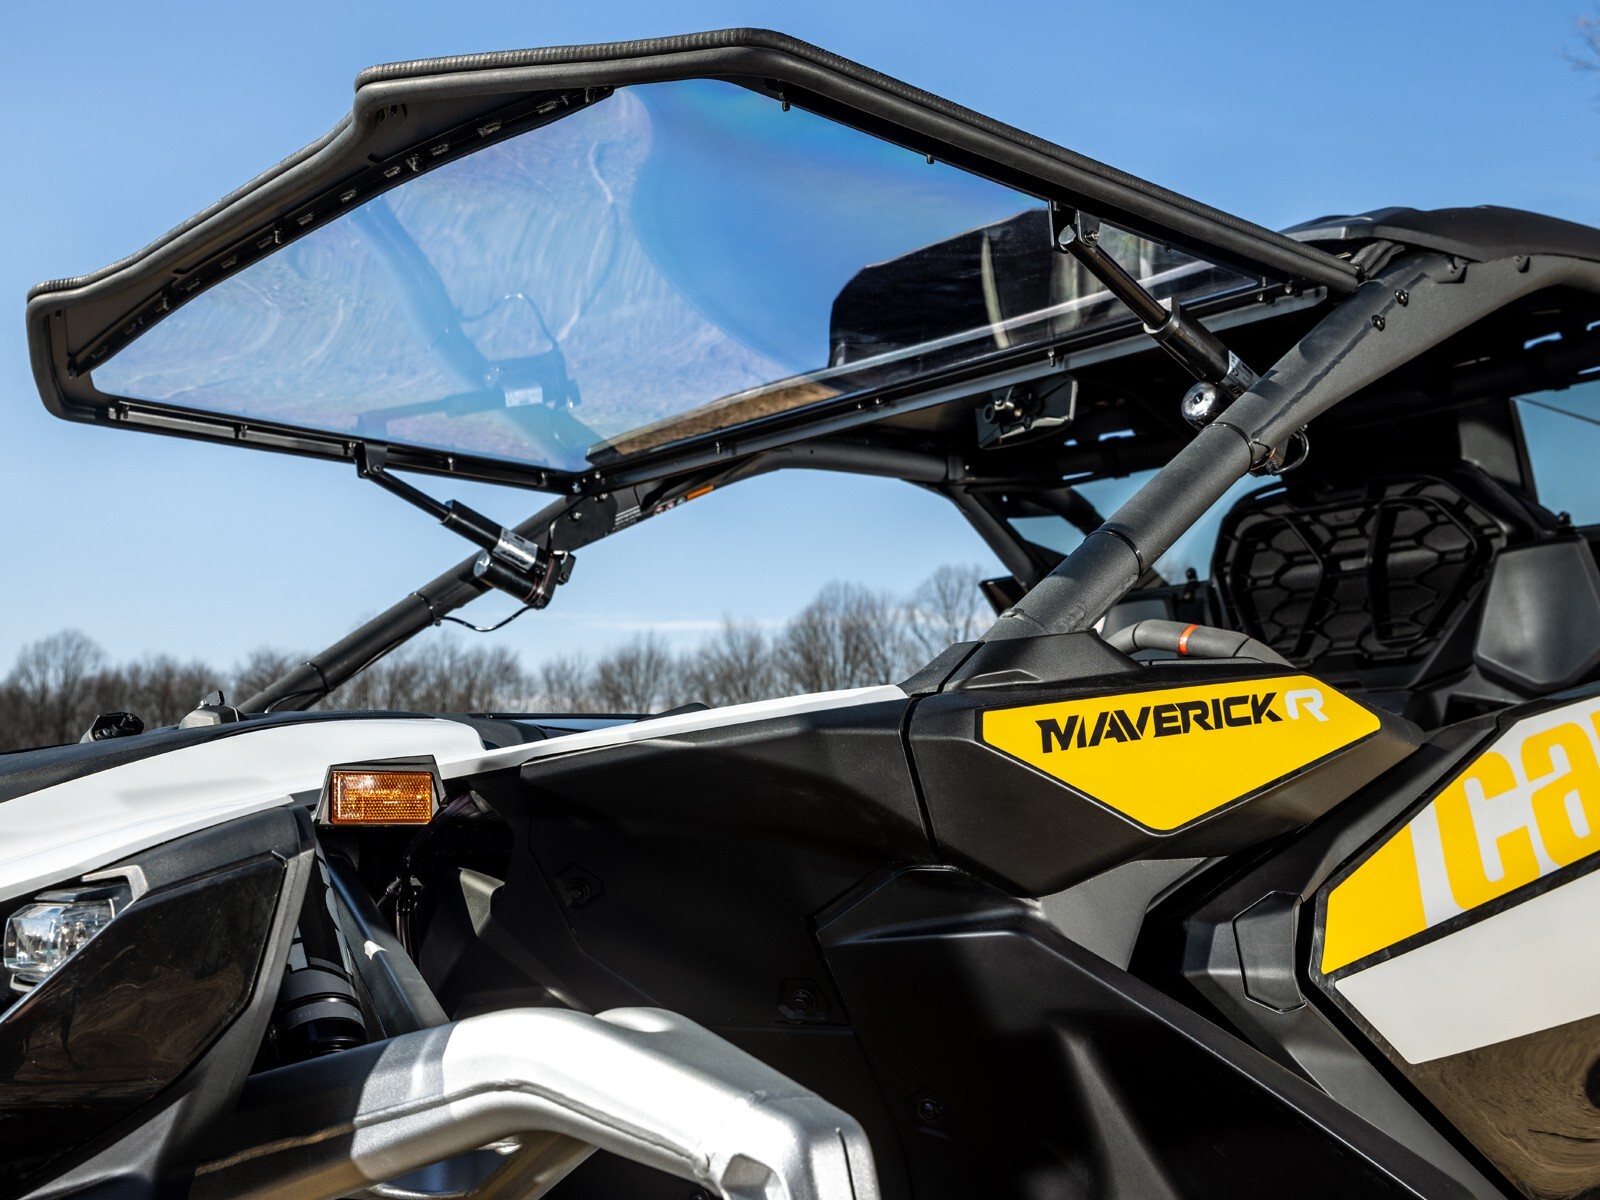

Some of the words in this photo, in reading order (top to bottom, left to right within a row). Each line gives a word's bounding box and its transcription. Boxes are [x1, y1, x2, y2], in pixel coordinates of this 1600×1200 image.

[1035, 692, 1282, 753] MAVERICK
[1285, 688, 1330, 722] R
[1434, 711, 1600, 911] ca
